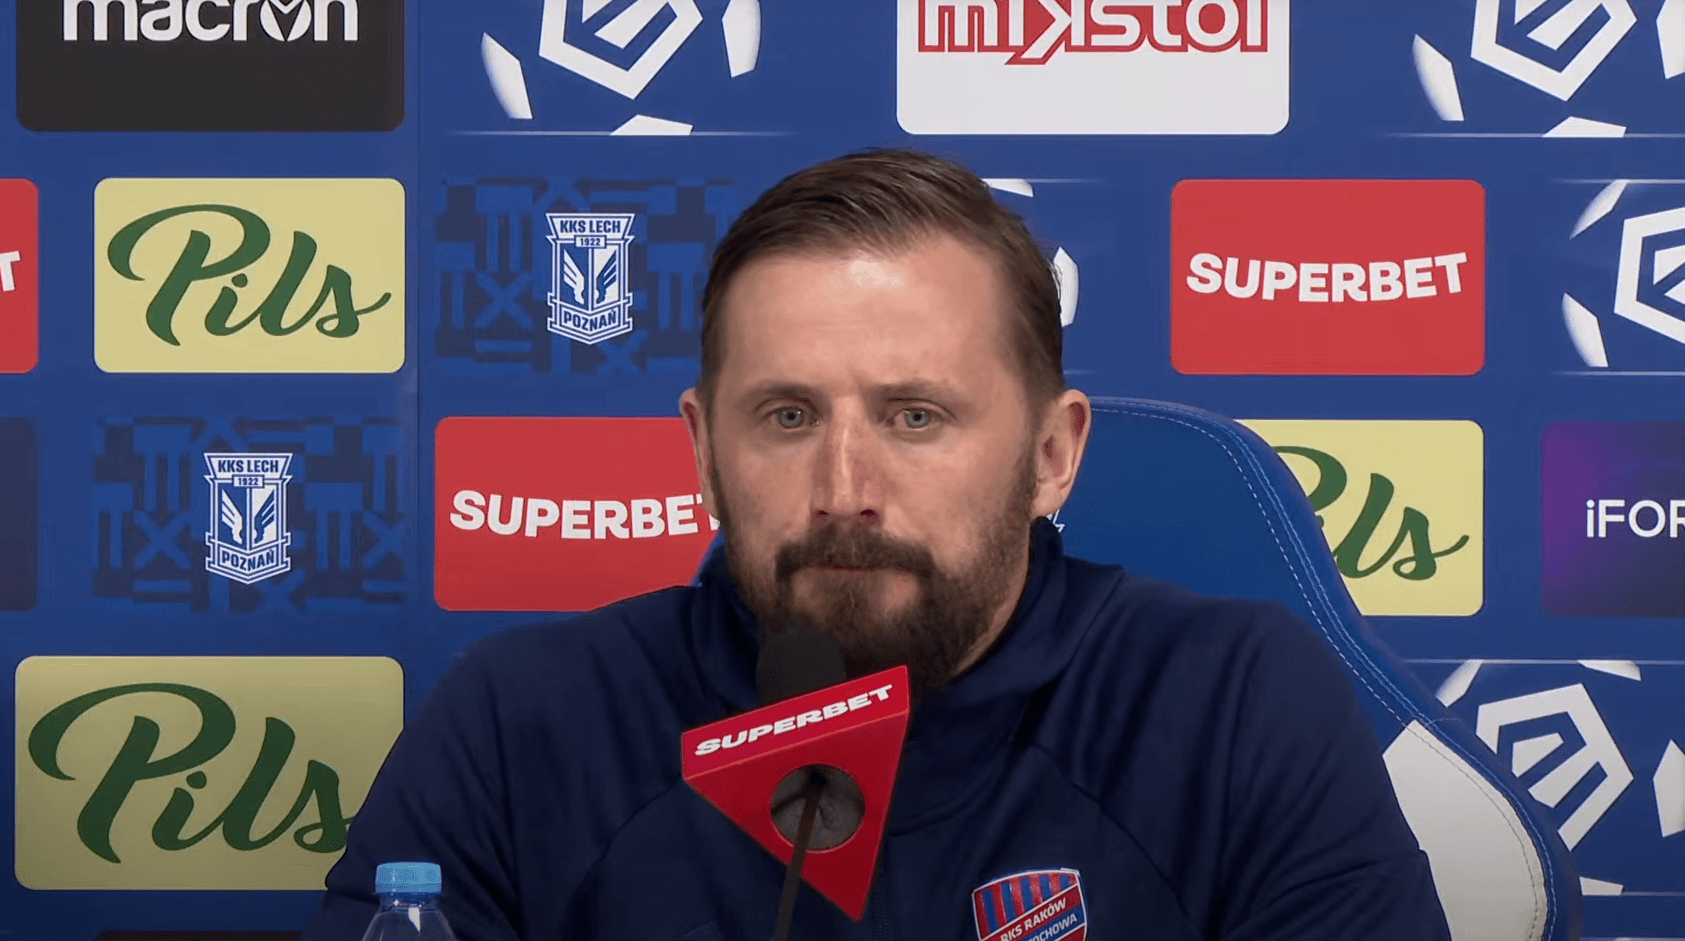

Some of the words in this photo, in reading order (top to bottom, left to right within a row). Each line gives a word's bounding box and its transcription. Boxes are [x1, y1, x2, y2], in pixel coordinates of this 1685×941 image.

[62, 0, 359, 42] macron
[559, 220, 586, 234] KKS
[589, 220, 621, 234] LECH
[579, 237, 602, 247] 1922
[107, 204, 391, 346] Pils
[1186, 251, 1468, 303] SUPERBET
[563, 308, 617, 332] POZNAŃ
[217, 459, 244, 473] KKS
[247, 459, 279, 473] LECH
[238, 477, 259, 486] 1922
[221, 549, 275, 572] POZNAŃ
[694, 684, 893, 756] SUPERBET
[28, 682, 352, 864] Pils
[1024, 897, 1067, 931] RAKÓW
